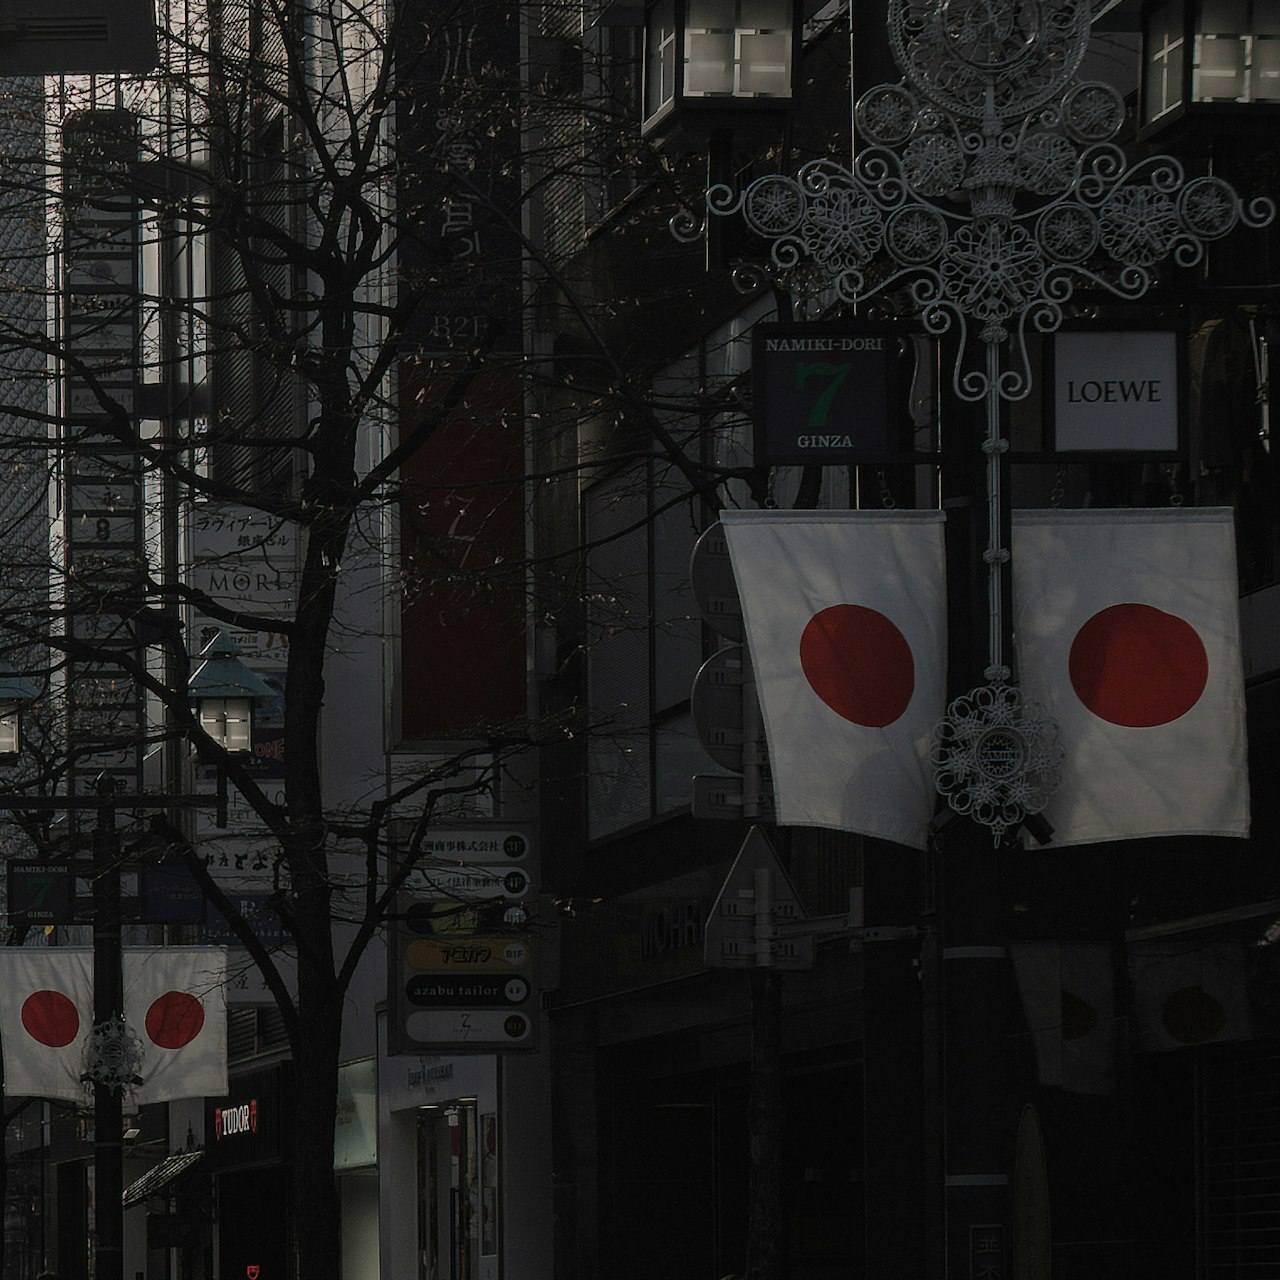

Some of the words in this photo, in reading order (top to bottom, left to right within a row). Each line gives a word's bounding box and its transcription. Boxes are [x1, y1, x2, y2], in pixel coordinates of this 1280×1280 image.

[764, 337, 883, 352] NAMIKI-DORI
[795, 362, 854, 428] 7
[1067, 380, 1162, 403] LOEWE
[797, 434, 854, 449] GINZA
[14, 866, 67, 874] NAMIKI-DORI
[27, 877, 56, 908] 7
[506, 950, 524, 959] B1F
[414, 986, 454, 995] azabu
[460, 985, 499, 995] tailor
[221, 1105, 250, 1136] TUDOR
